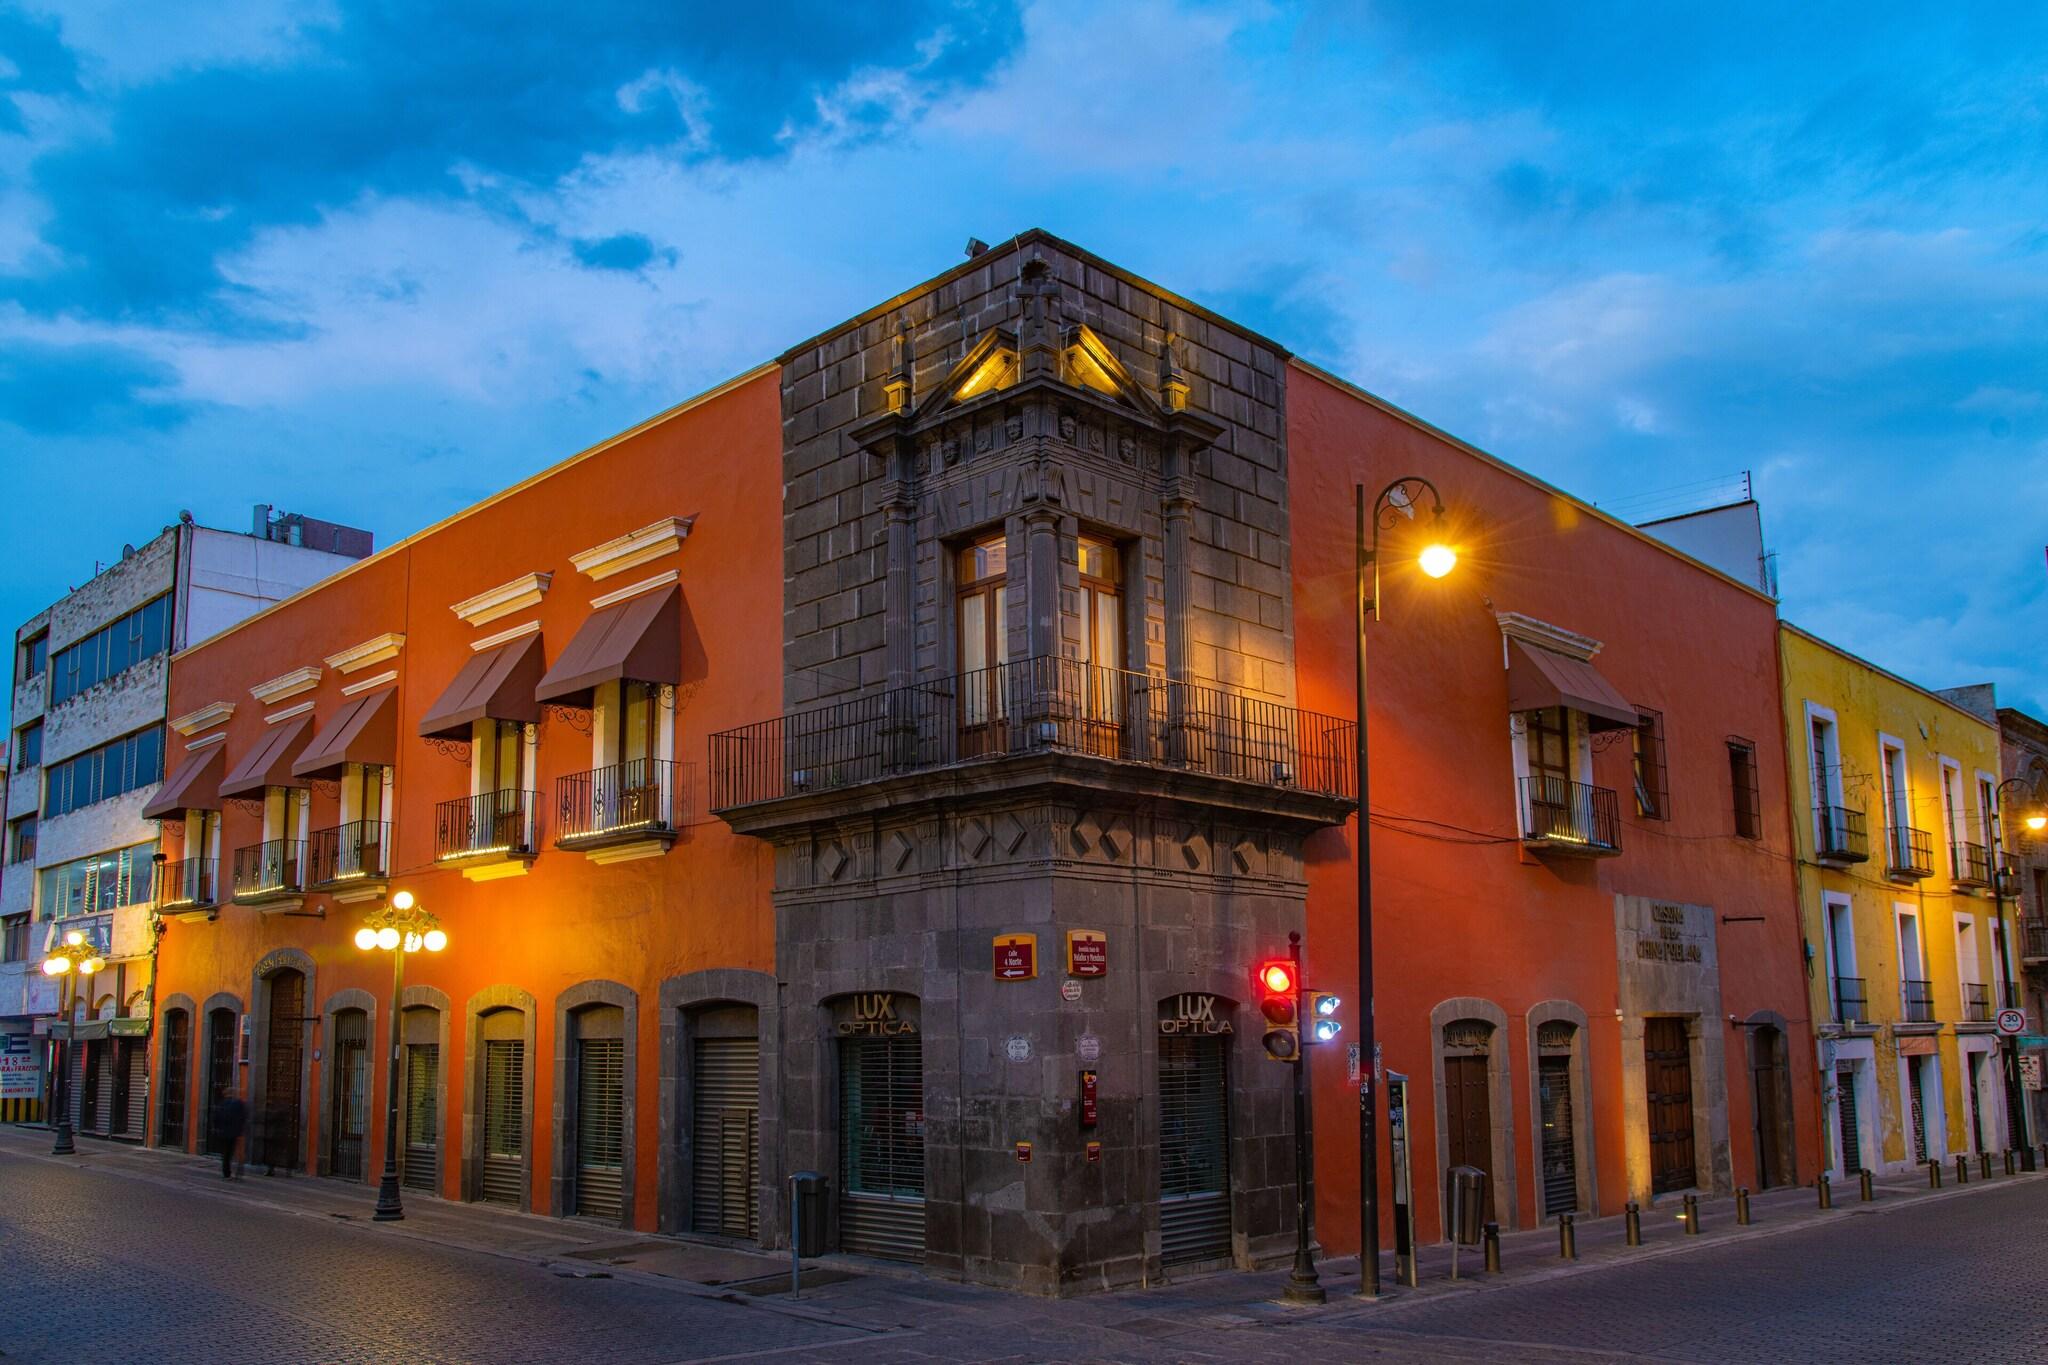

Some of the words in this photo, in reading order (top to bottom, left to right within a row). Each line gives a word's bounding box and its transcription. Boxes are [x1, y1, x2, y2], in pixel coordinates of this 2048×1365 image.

[1008, 957, 1023, 966] Norte
[854, 994, 896, 1019] LUX
[1178, 994, 1216, 1020] LUX
[2005, 1014, 2018, 1023] 30
[839, 1021, 917, 1034] OPTICA
[1161, 1019, 1234, 1034] OPTICA
